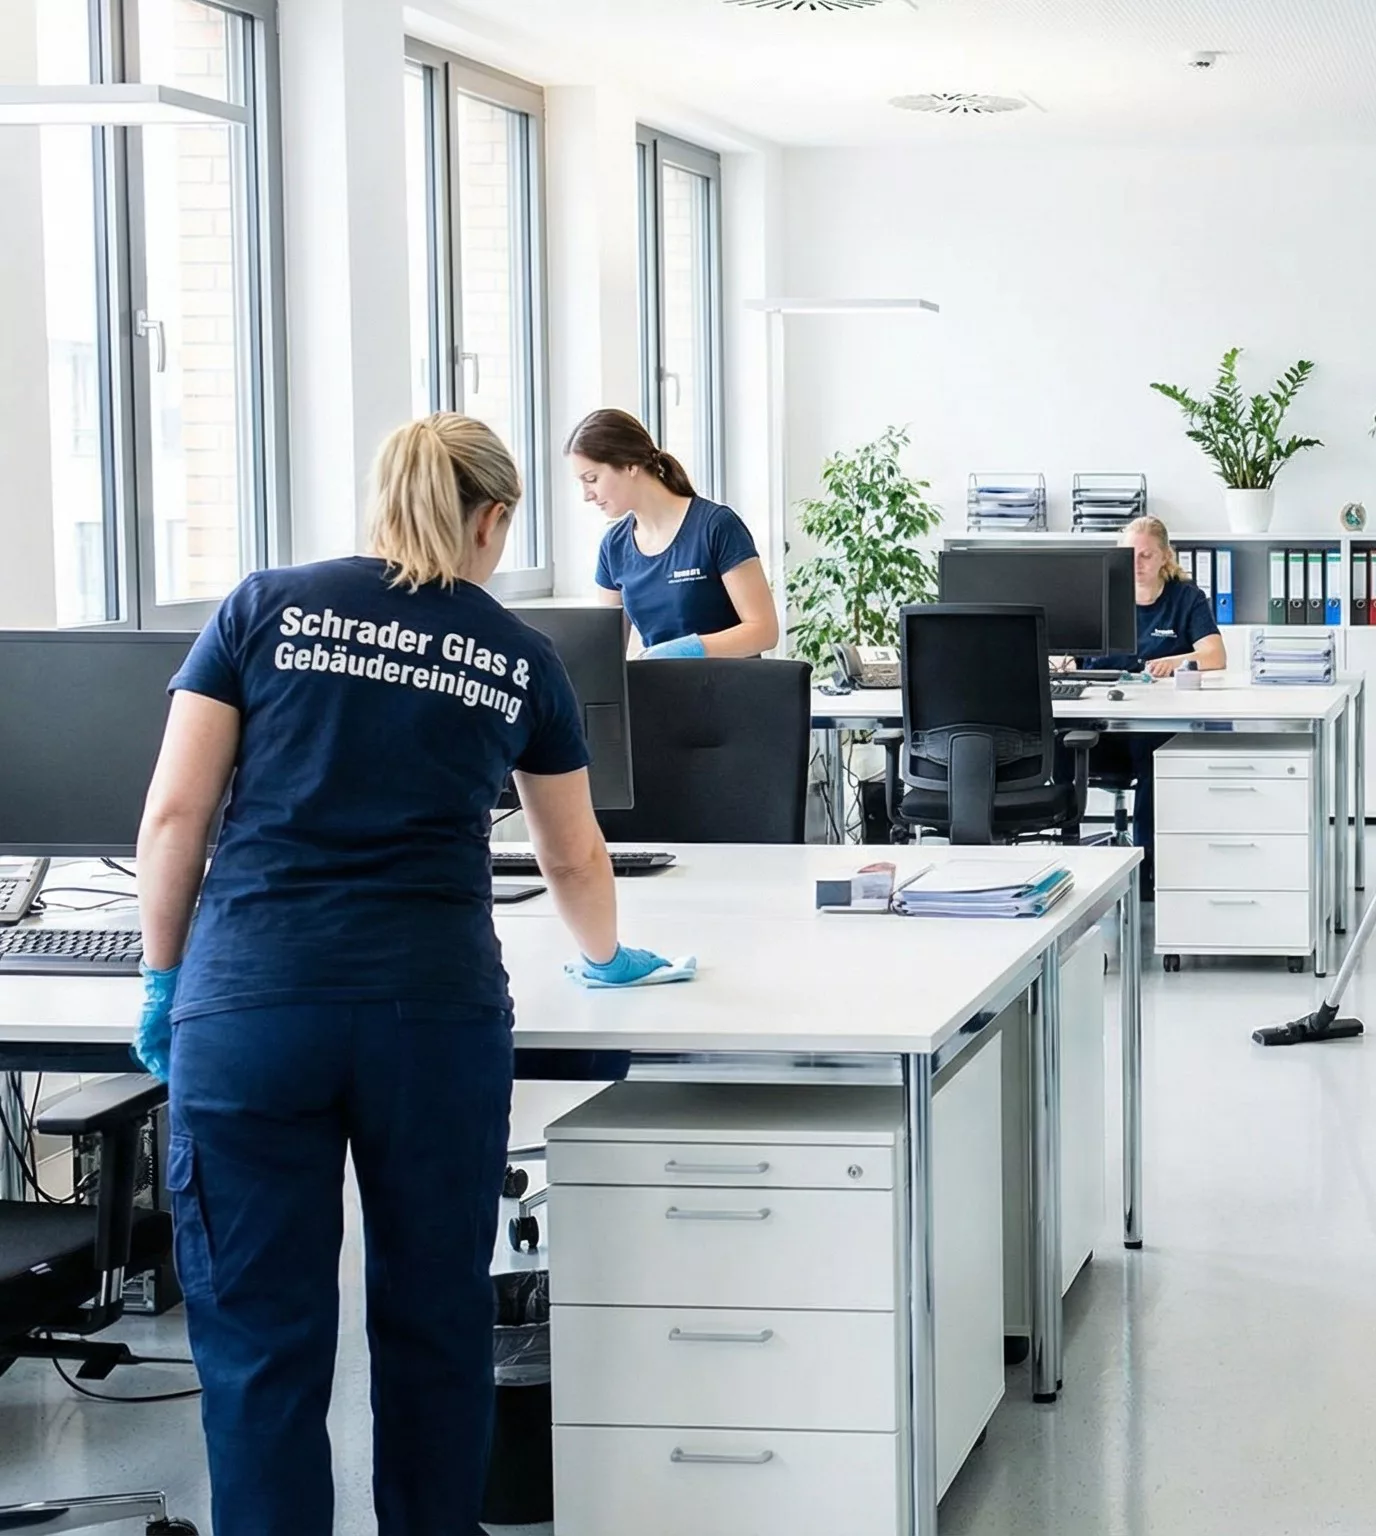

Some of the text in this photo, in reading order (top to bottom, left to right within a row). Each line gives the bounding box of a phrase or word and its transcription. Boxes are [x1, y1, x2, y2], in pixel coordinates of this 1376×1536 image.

[274, 641, 523, 725] Gebäudereinigung
[279, 606, 531, 691] Schrader Glas &
